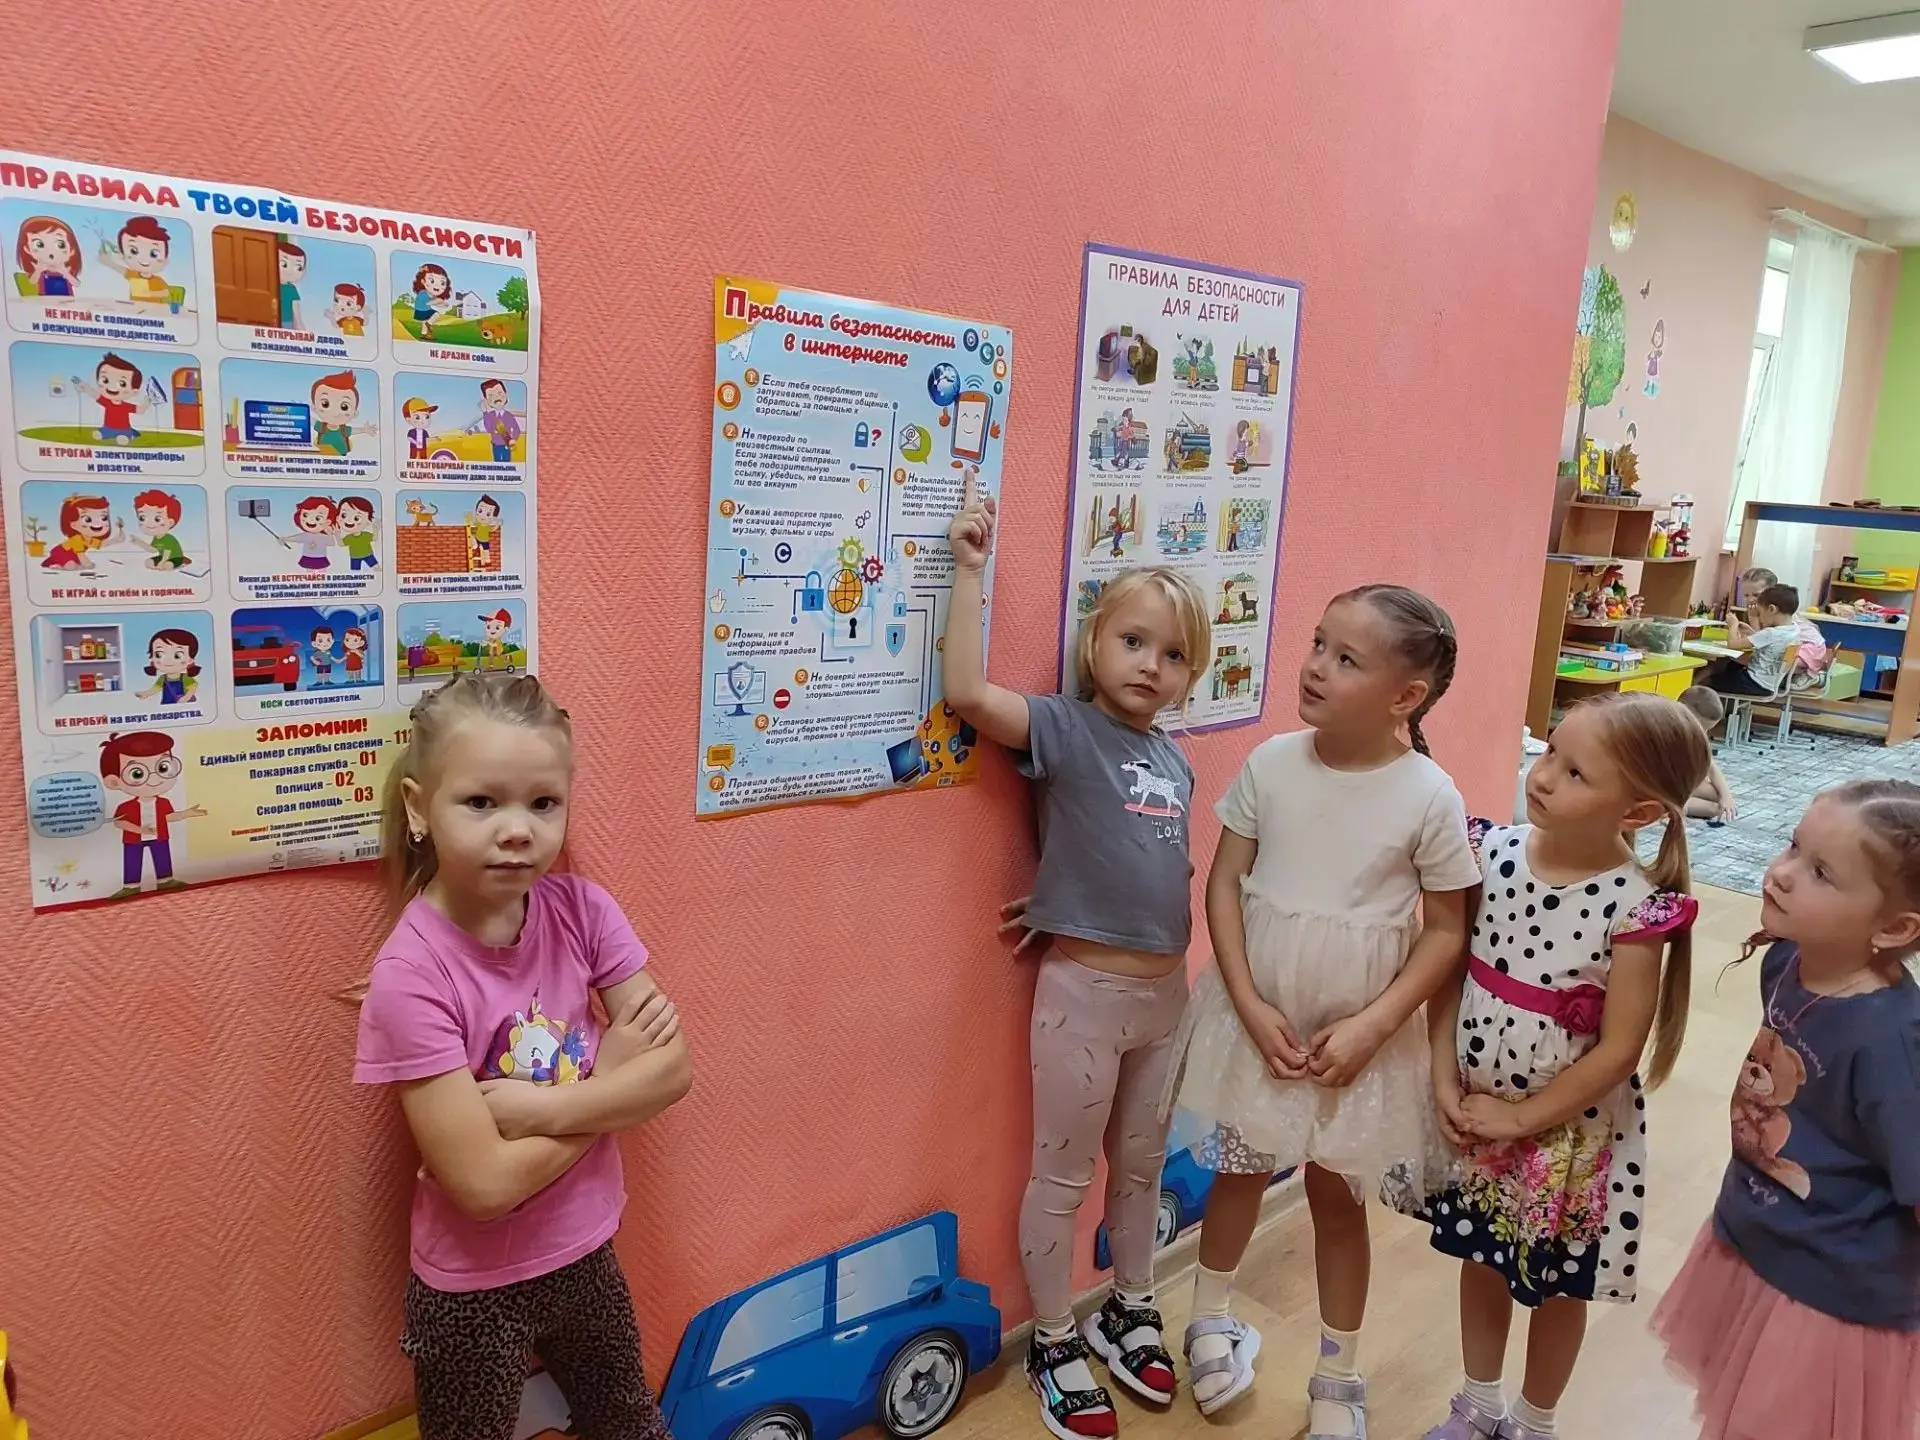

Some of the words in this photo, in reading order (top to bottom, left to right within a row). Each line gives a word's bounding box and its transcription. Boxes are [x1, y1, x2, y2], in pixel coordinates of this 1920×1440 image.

[0, 162, 180, 208] ПРАВИЛА
[187, 190, 299, 225] ТВОЕЙ
[305, 207, 523, 259] БЕЗОПАСНОСТИ
[1108, 263, 1178, 290] ПРАВИЛА
[1187, 276, 1285, 308] БЕЗОПАСНОСТИ
[45, 308, 57, 318] НЕ
[60, 309, 92, 322] ИГРАЙ
[94, 314, 100, 322] с
[103, 315, 164, 328] колющими
[725, 288, 824, 329] Правила
[829, 313, 956, 349] безопасности
[1162, 297, 1190, 317] ДЛЯ
[1198, 303, 1240, 323] ДЕТЕЙ
[254, 328, 265, 338] НЕ
[267, 330, 315, 341] ОТКРЫВАЙ
[316, 336, 344, 345] дверь
[784, 333, 795, 350] в
[802, 338, 908, 367] интернете
[762, 374, 785, 387] Если
[787, 382, 810, 390] тебя
[812, 385, 862, 397] оскорбляют
[864, 390, 878, 398] или
[756, 387, 812, 400] запугивают,
[813, 394, 853, 404] прекрати
[855, 396, 890, 409] общение.
[756, 395, 800, 408] Обратись
[813, 403, 853, 414] помощью
[755, 407, 802, 417] взрослым!
[741, 427, 755, 440] Не
[757, 434, 796, 443] переходи
[39, 447, 52, 457] НЕ
[54, 447, 92, 458] ТРОГАЙ
[94, 450, 185, 462] электроприборы
[735, 450, 757, 459] Если
[758, 452, 800, 462] знакомый
[801, 456, 841, 465] отправил
[734, 460, 757, 468] тебе
[759, 462, 829, 473] подозрительную
[907, 472, 919, 483] Не
[920, 477, 961, 486] выкладывай
[736, 503, 771, 515] Уважай
[773, 510, 817, 518] авторское
[819, 512, 844, 520] право,
[745, 517, 785, 526] скачивай
[786, 520, 832, 528] пиратскую
[732, 527, 767, 535] музыку,
[769, 528, 804, 536] фильмы
[814, 529, 835, 537] игры
[51, 589, 64, 598] НЕ
[66, 587, 97, 598] ИГРАЙ
[109, 588, 139, 597] огнём
[150, 588, 194, 596] горячим.
[733, 628, 765, 639] Помни,
[726, 648, 777, 658] интернете
[778, 647, 816, 655] правдива
[727, 640, 782, 650] информация
[810, 671, 822, 681] Не
[824, 673, 856, 681] доверяй
[857, 671, 904, 680] незнакомцам
[55, 718, 67, 727] НЕ
[69, 715, 108, 727] ПРОБУЙ
[110, 716, 123, 724] на
[125, 714, 148, 723] вкус
[150, 710, 202, 721] лекарства.
[772, 717, 814, 727] Установи
[816, 714, 872, 723] антивирусные
[874, 709, 915, 720] программы,
[256, 718, 367, 742] ЗАПОМНИ!
[199, 751, 246, 766] Единый
[249, 749, 285, 761] номер
[287, 743, 331, 757] службы
[334, 737, 383, 752] спасения
[249, 765, 305, 779] Пожарная
[308, 759, 348, 774] служба
[359, 750, 376, 766] 01
[275, 780, 323, 795] Полиция
[335, 771, 354, 787] 02
[728, 777, 767, 789] Правила
[769, 775, 806, 785] общения
[815, 772, 835, 780] сети
[837, 768, 861, 776] такие
[862, 767, 873, 775] же,
[256, 802, 297, 816] Скорая
[299, 797, 343, 811] помощь
[354, 786, 373, 802] 03
